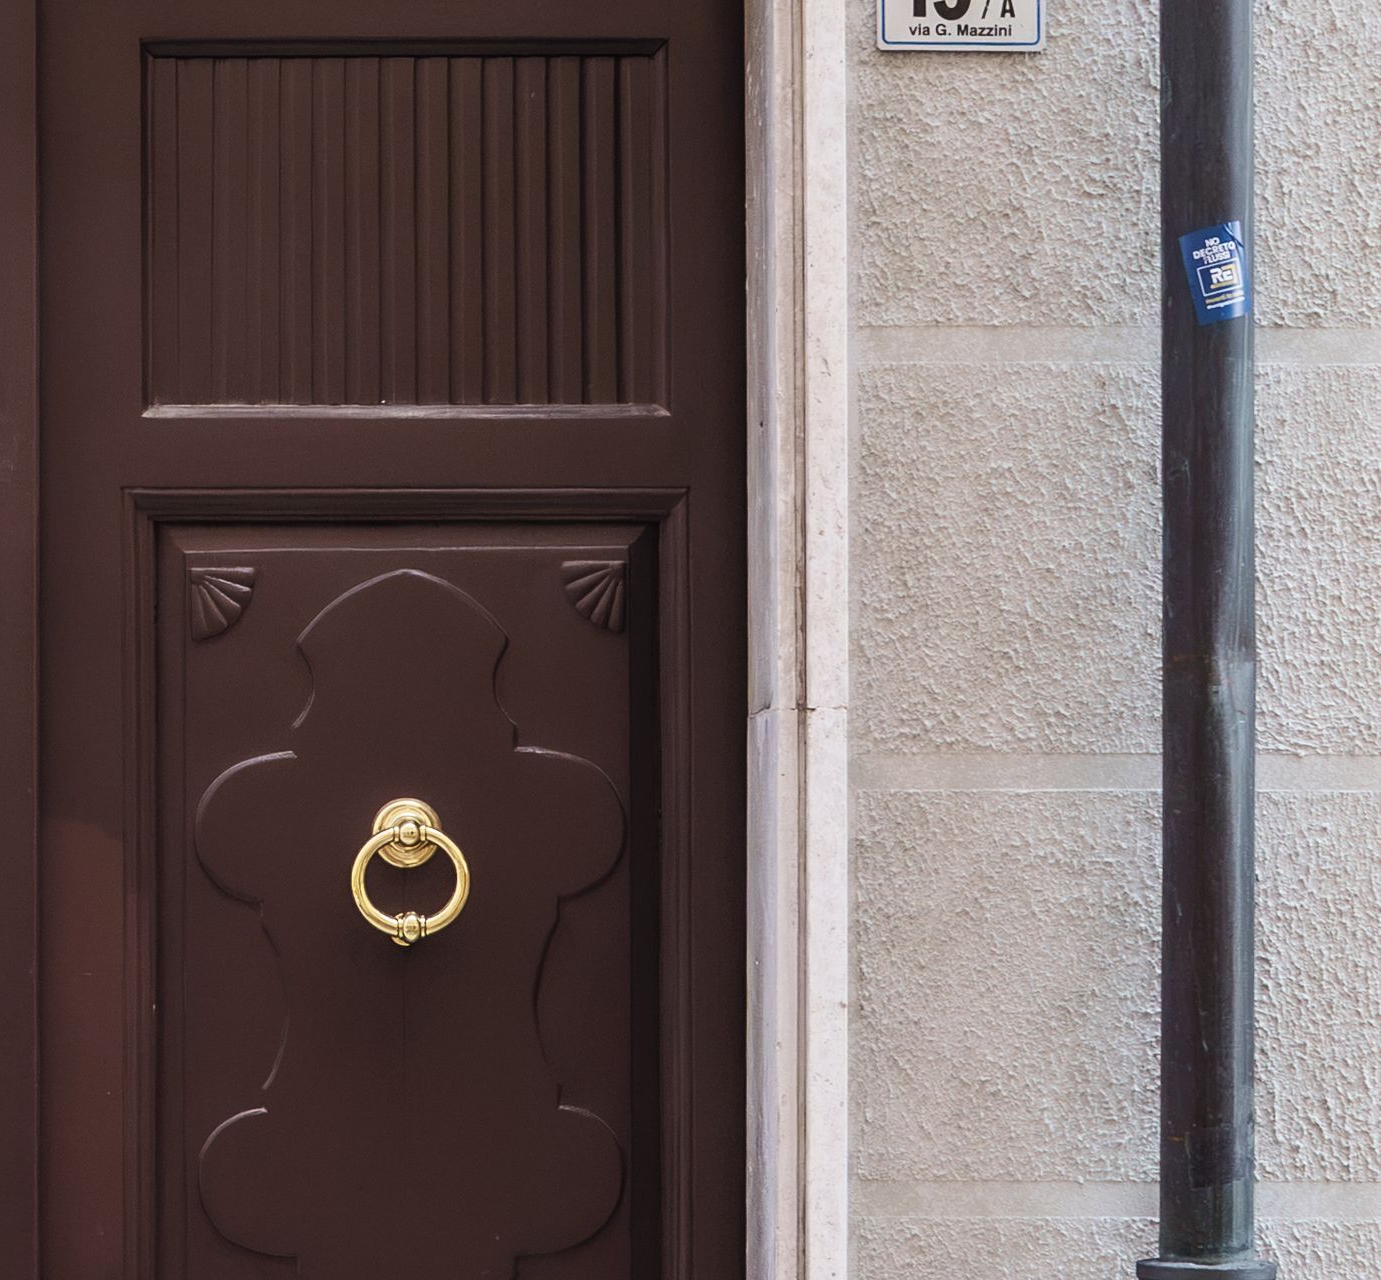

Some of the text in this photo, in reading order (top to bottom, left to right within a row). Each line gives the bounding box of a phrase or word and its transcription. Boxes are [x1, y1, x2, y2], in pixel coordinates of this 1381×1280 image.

[909, 24, 1012, 37] via G. Mazzini
[1204, 237, 1220, 247] NO
[1192, 241, 1236, 260] DECRETO
